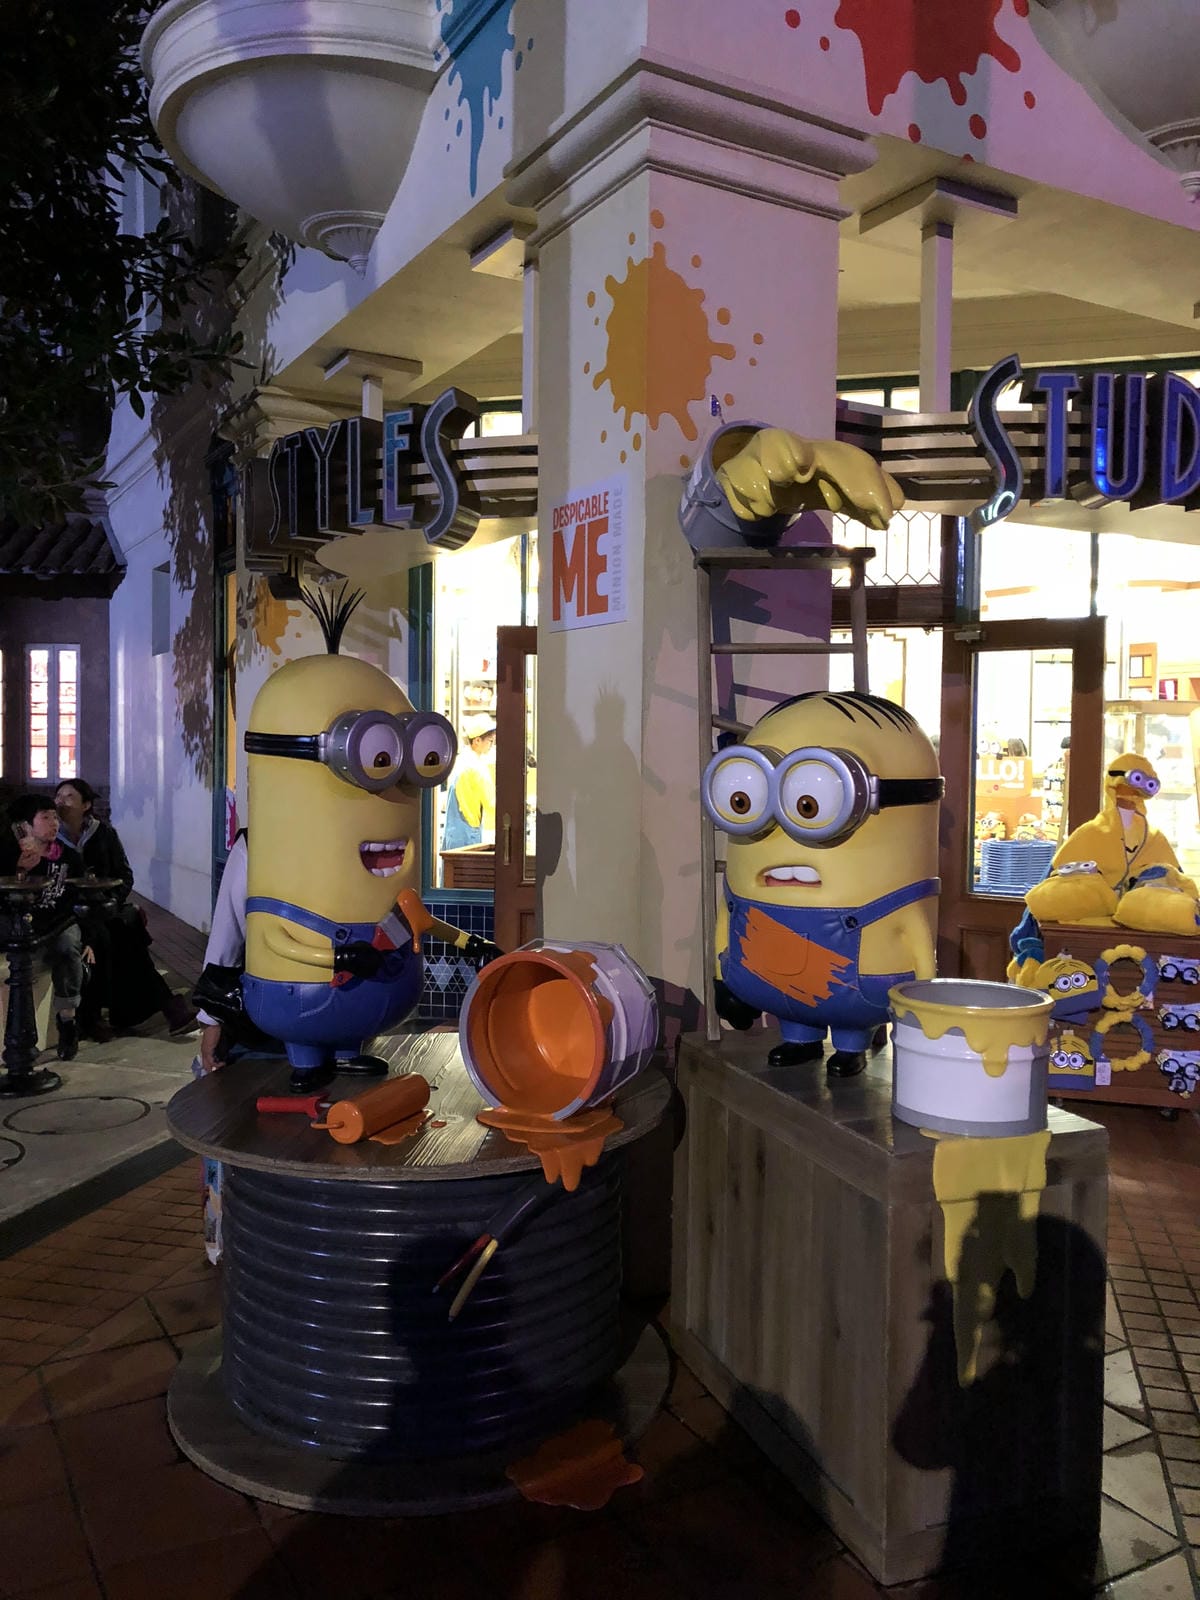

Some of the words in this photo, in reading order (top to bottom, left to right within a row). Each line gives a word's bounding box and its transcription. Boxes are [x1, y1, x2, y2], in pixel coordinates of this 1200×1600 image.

[267, 387, 460, 546] STYLES
[552, 491, 609, 530] DESPICABLE
[552, 516, 609, 622] ME
